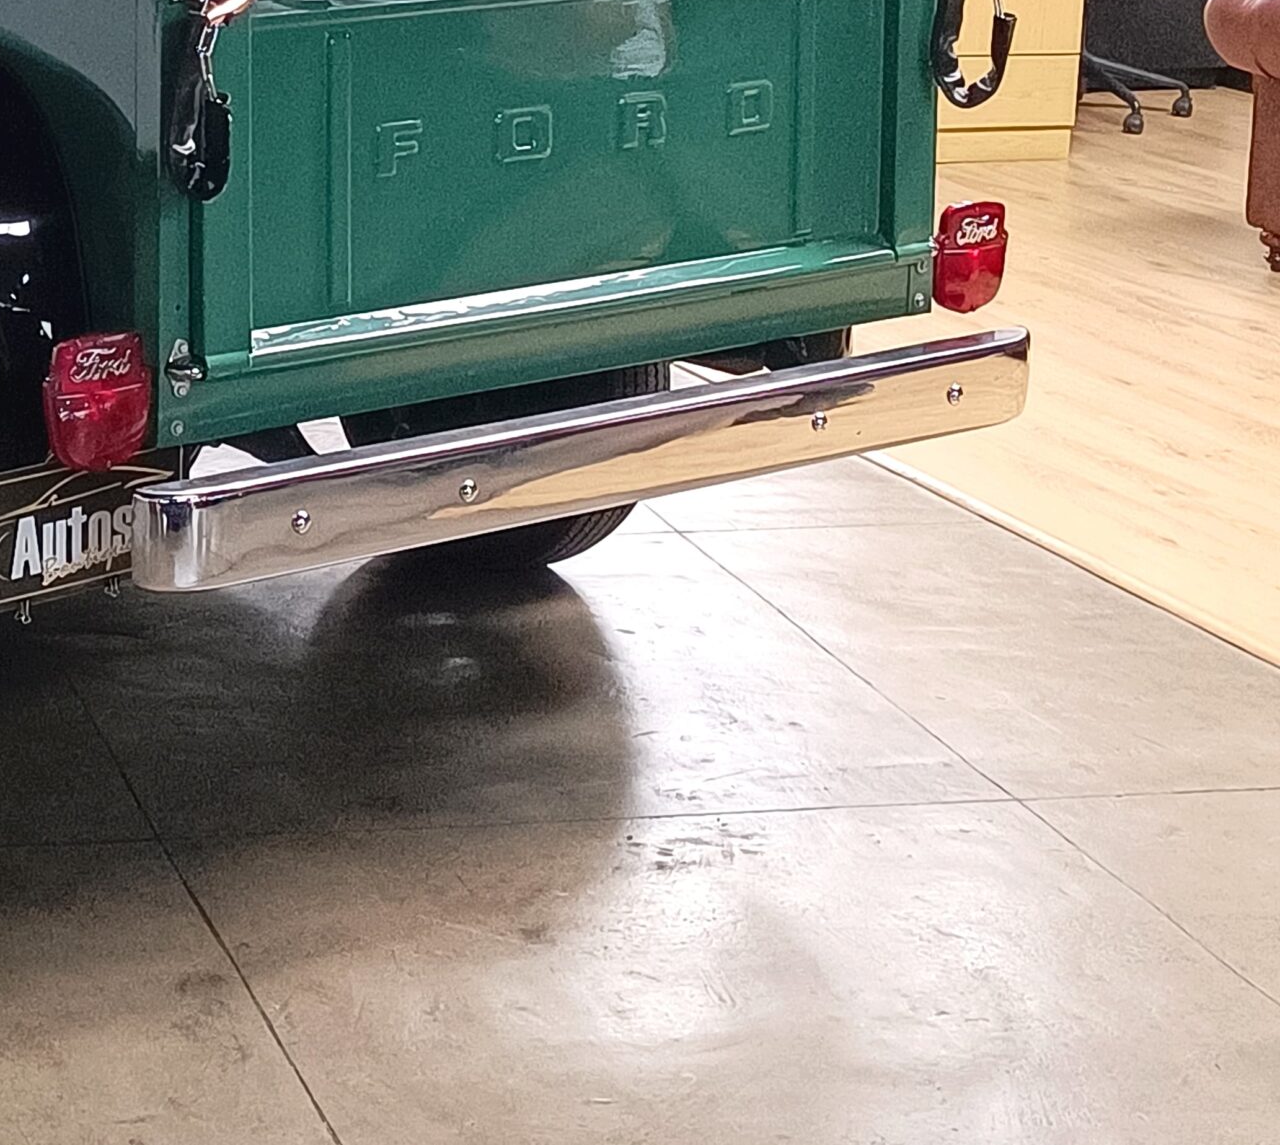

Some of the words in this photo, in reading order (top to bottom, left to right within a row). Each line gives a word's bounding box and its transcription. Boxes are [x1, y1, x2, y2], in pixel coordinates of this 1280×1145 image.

[376, 79, 773, 178] FORD
[956, 215, 999, 246] Ford
[70, 347, 132, 383] Ford
[10, 504, 134, 581] Autos
